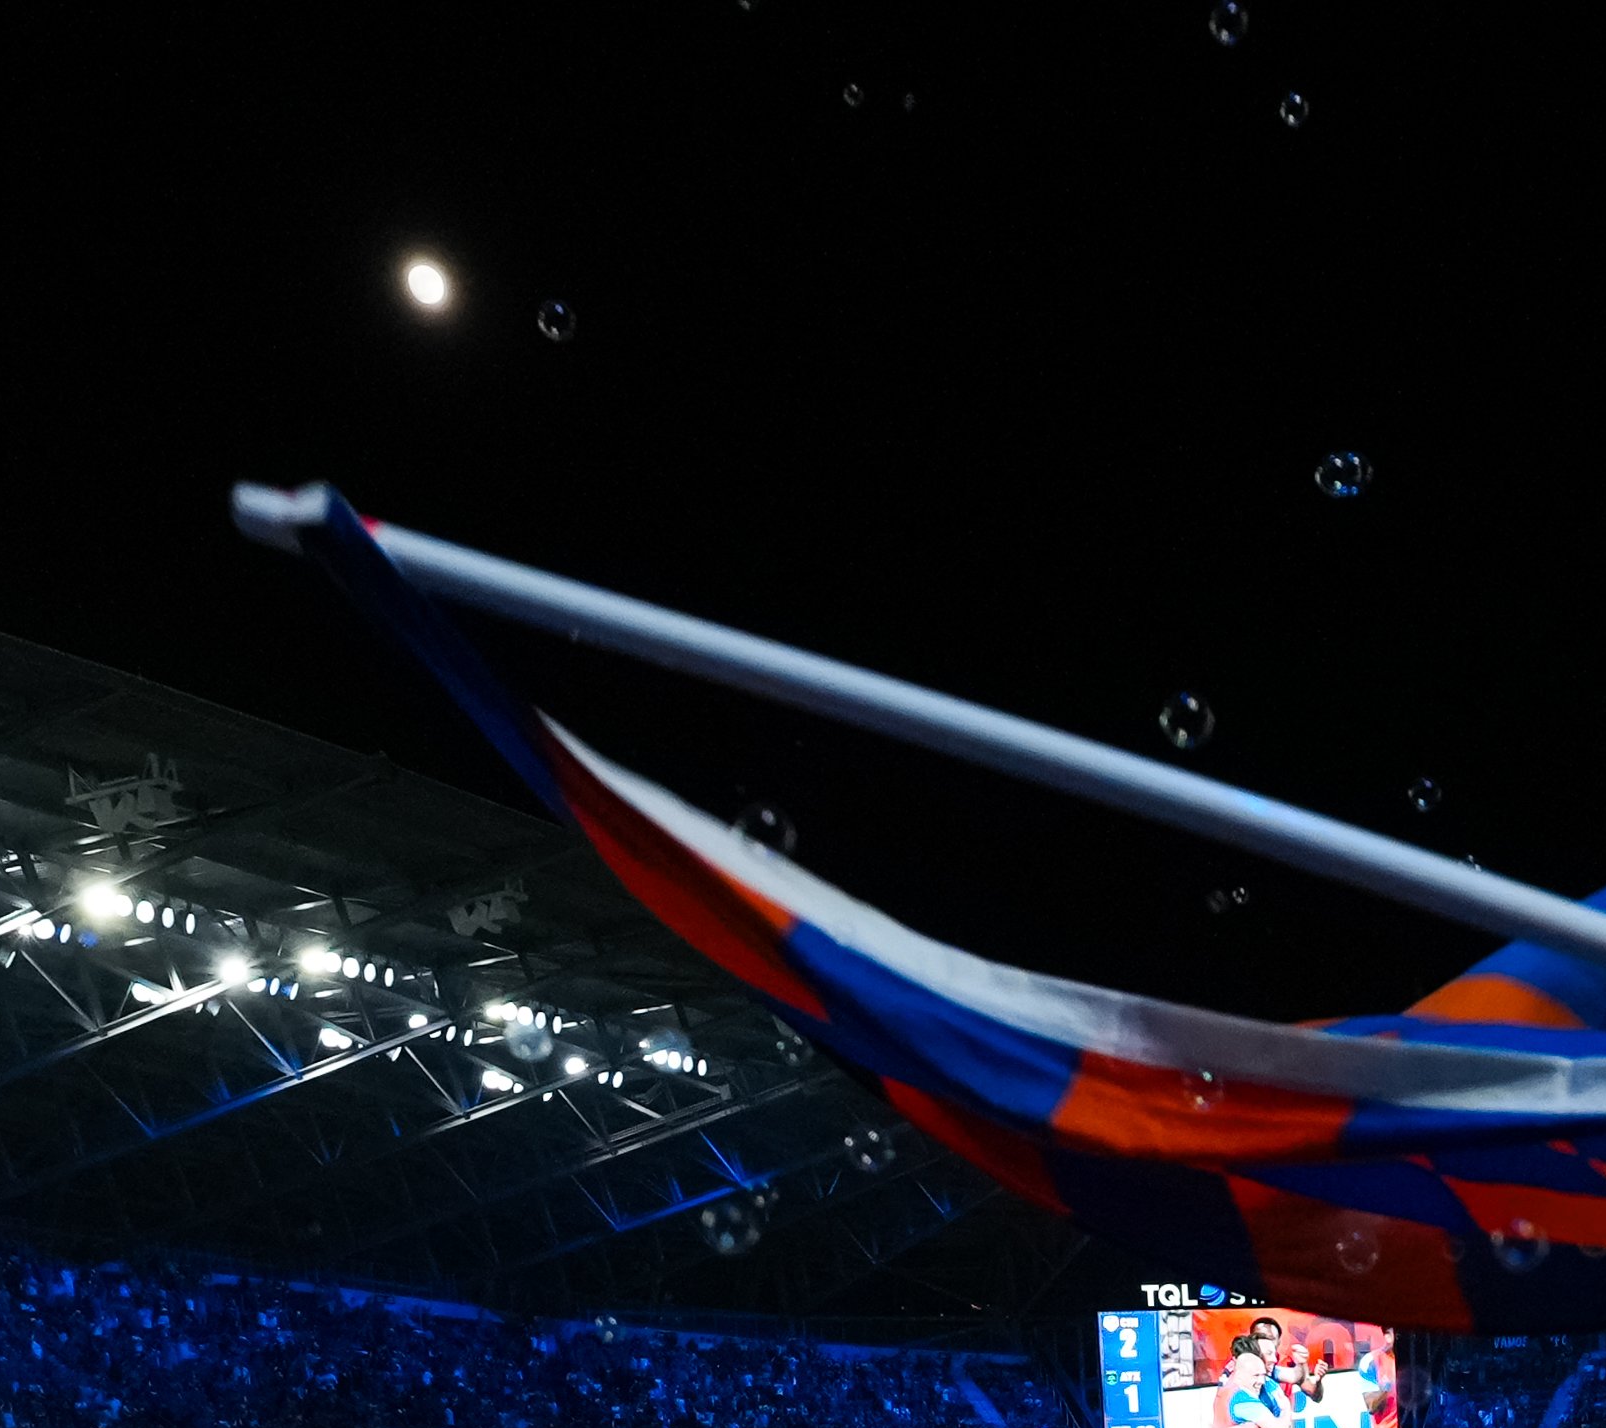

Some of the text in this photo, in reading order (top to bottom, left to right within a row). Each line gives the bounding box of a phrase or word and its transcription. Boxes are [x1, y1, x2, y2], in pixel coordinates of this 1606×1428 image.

[1141, 1284, 1198, 1307] TQL
[1119, 1328, 1137, 1358] 2
[1123, 1384, 1139, 1413] 1
